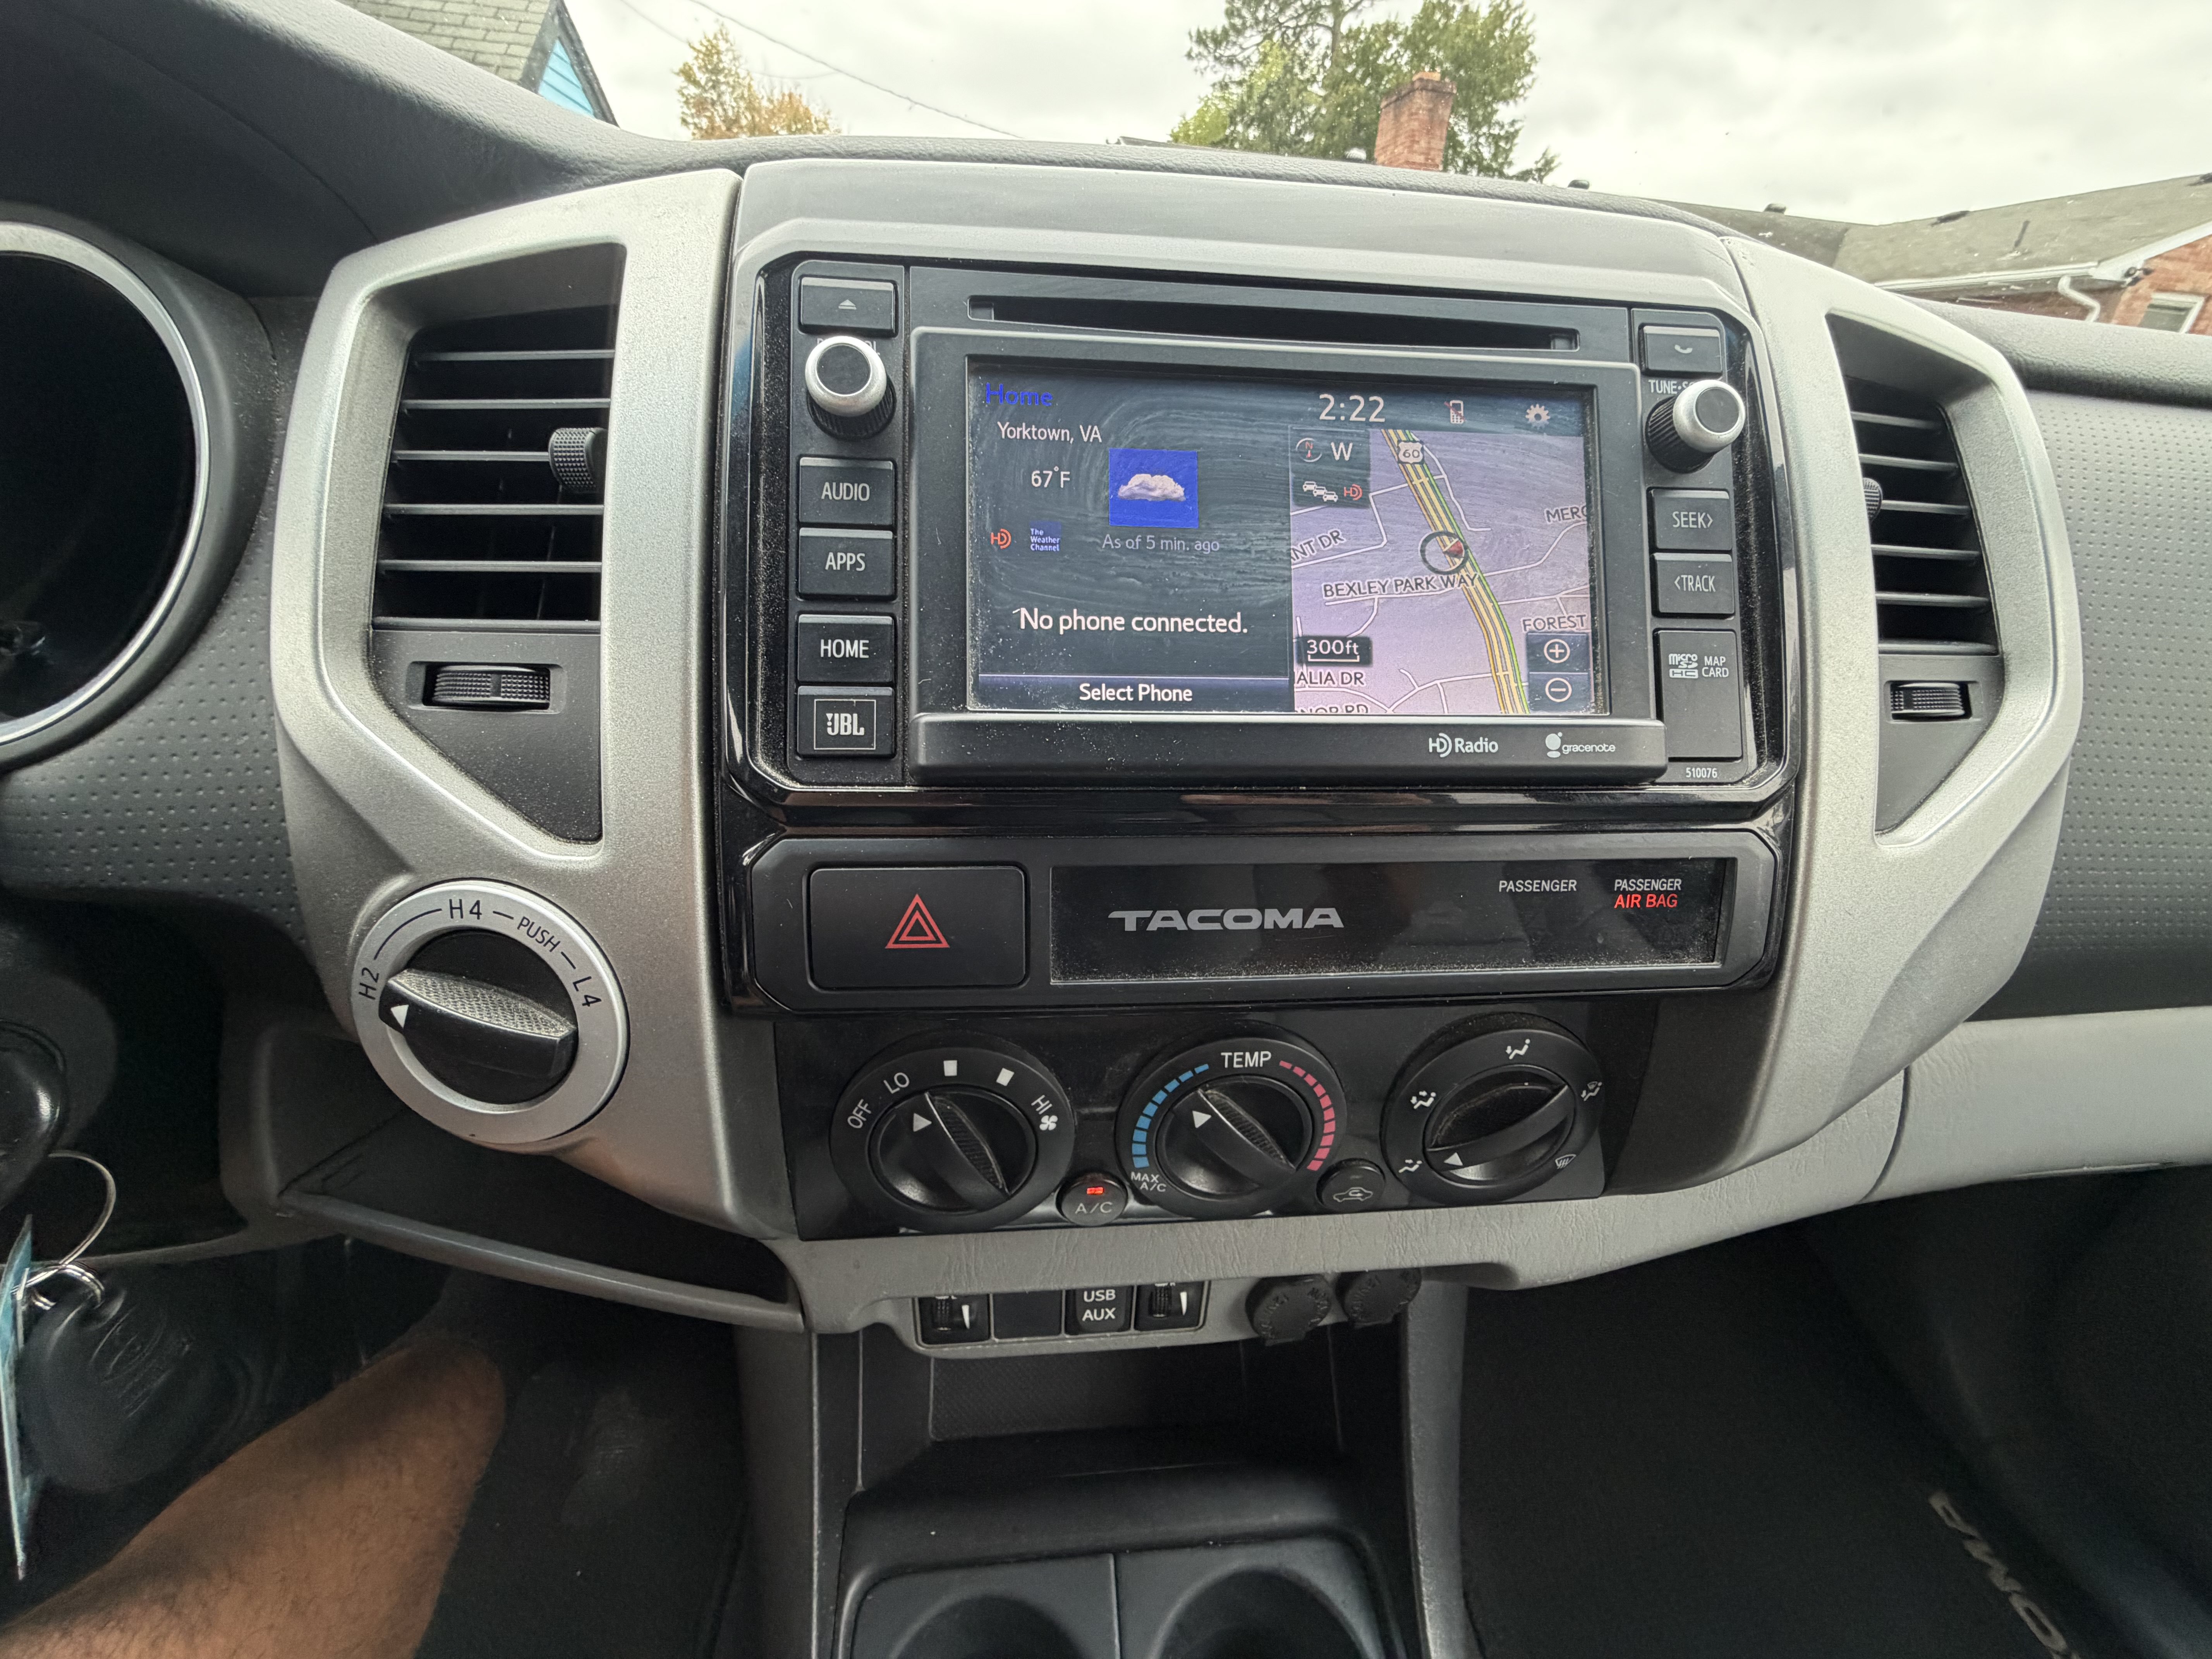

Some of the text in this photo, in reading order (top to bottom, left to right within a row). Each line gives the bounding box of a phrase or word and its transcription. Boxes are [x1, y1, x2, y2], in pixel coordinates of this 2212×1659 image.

[986, 383, 1053, 406] Home
[1319, 393, 1385, 422] 2:22
[998, 421, 1102, 444] Yorktown, VA
[1331, 442, 1353, 460] W
[1403, 448, 1420, 459] 60
[821, 482, 870, 501] AUDIO
[1102, 534, 1219, 554] As of 5 min. ago
[1291, 530, 1344, 561] NT DR
[825, 552, 865, 571] APPS
[1324, 574, 1478, 598] BEXLEY PARK WAY
[1020, 608, 1248, 635] No phone connected.
[1523, 615, 1586, 631] FOREST
[821, 639, 869, 658] HOME
[1307, 640, 1358, 655] 300ft
[1704, 656, 1726, 666] MAP
[1341, 672, 1364, 685] DR
[1702, 667, 1729, 677] CARD
[1080, 683, 1192, 702] Select Phone
[826, 713, 864, 735] JBL
[1429, 733, 1499, 757] HD Radio
[1562, 743, 1616, 753] gracenote
[1686, 767, 1717, 778] 510076
[1499, 879, 1577, 892] PASSENGER
[1614, 879, 1681, 891] PASSENGER
[449, 899, 482, 920] H4
[1614, 894, 1678, 908] AIR BAG
[1108, 908, 1344, 931] TACOMA
[517, 916, 561, 952] PUSH
[359, 967, 379, 1000] H2
[1221, 1051, 1271, 1068] TEMP
[883, 1072, 910, 1094] LO
[847, 1099, 871, 1129] OFF
[1031, 1095, 1053, 1115] HI
[1131, 1171, 1159, 1183] MAX
[1140, 1182, 1166, 1192] A/C
[1075, 1202, 1113, 1214] A/C
[1084, 1289, 1116, 1302] USB
[1082, 1308, 1115, 1321] AUX
